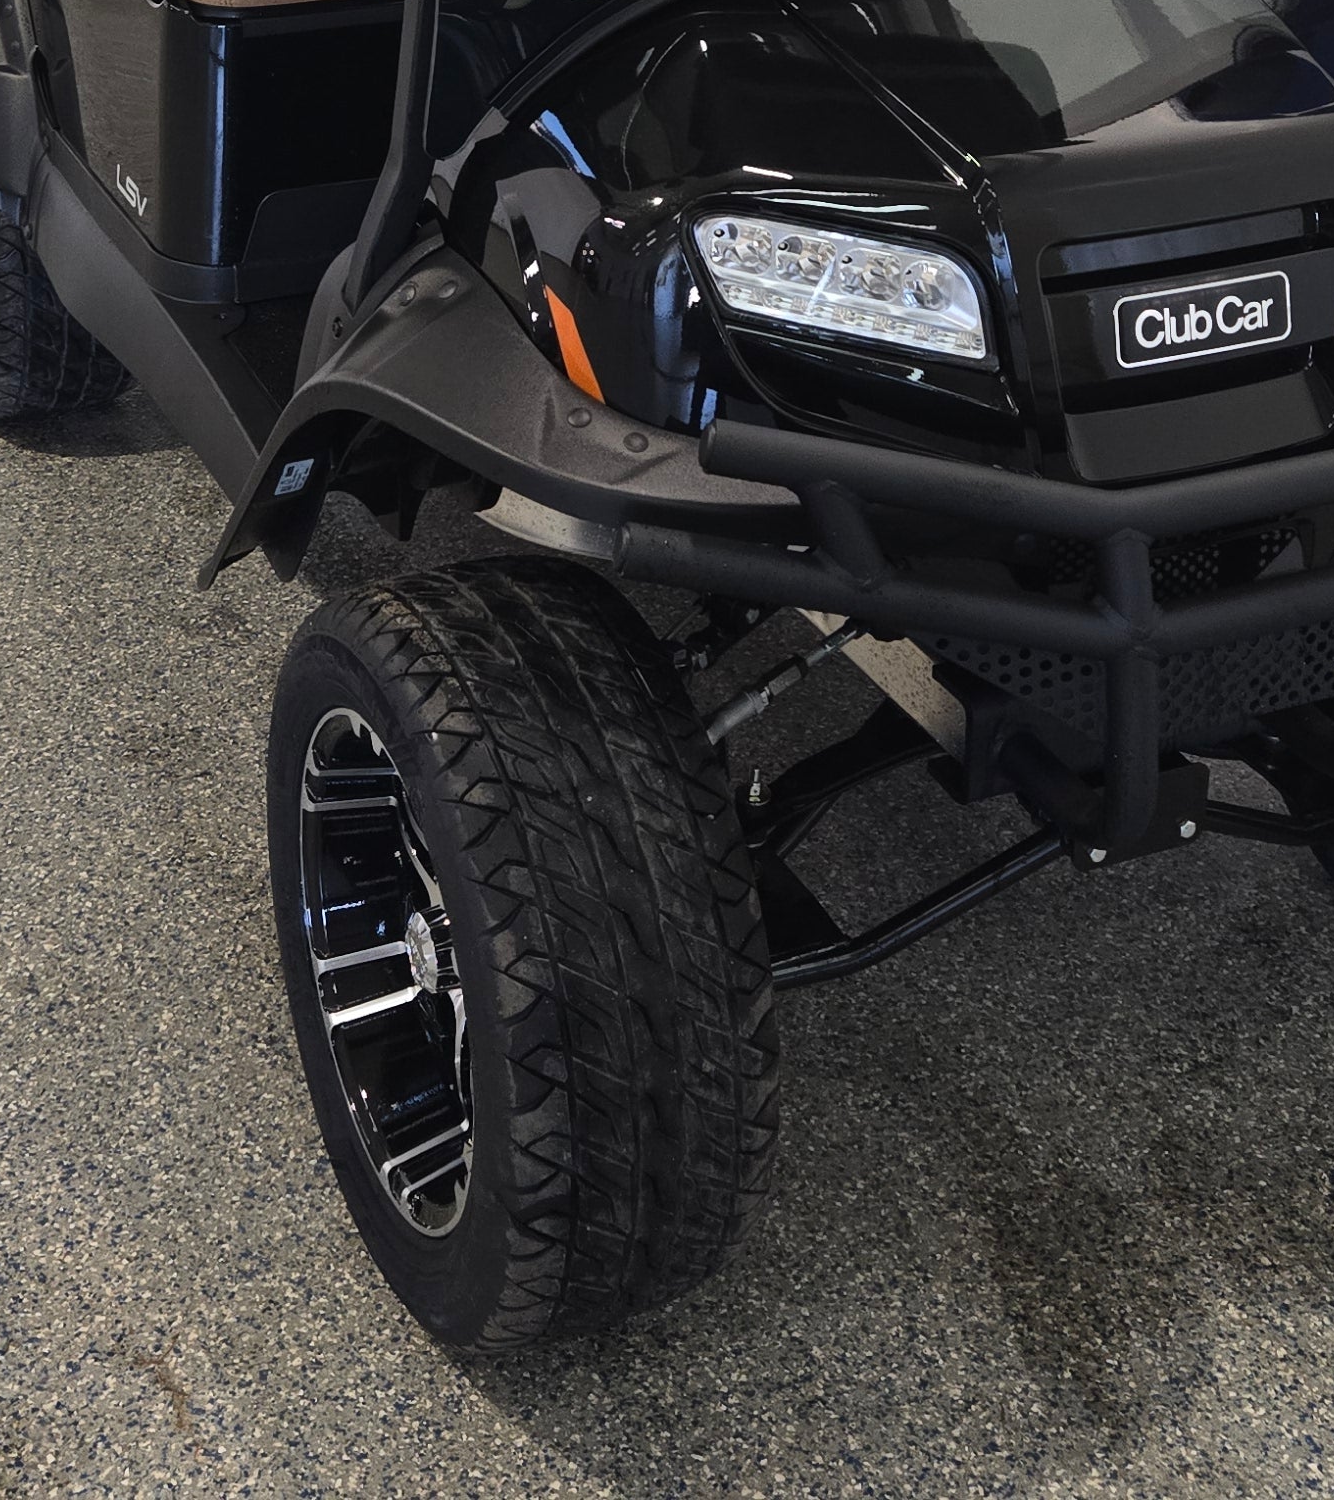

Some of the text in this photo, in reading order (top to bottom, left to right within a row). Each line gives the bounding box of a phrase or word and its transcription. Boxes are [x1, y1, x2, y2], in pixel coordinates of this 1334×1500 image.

[116, 163, 148, 217] LSV
[1134, 295, 1274, 349] Club Car
